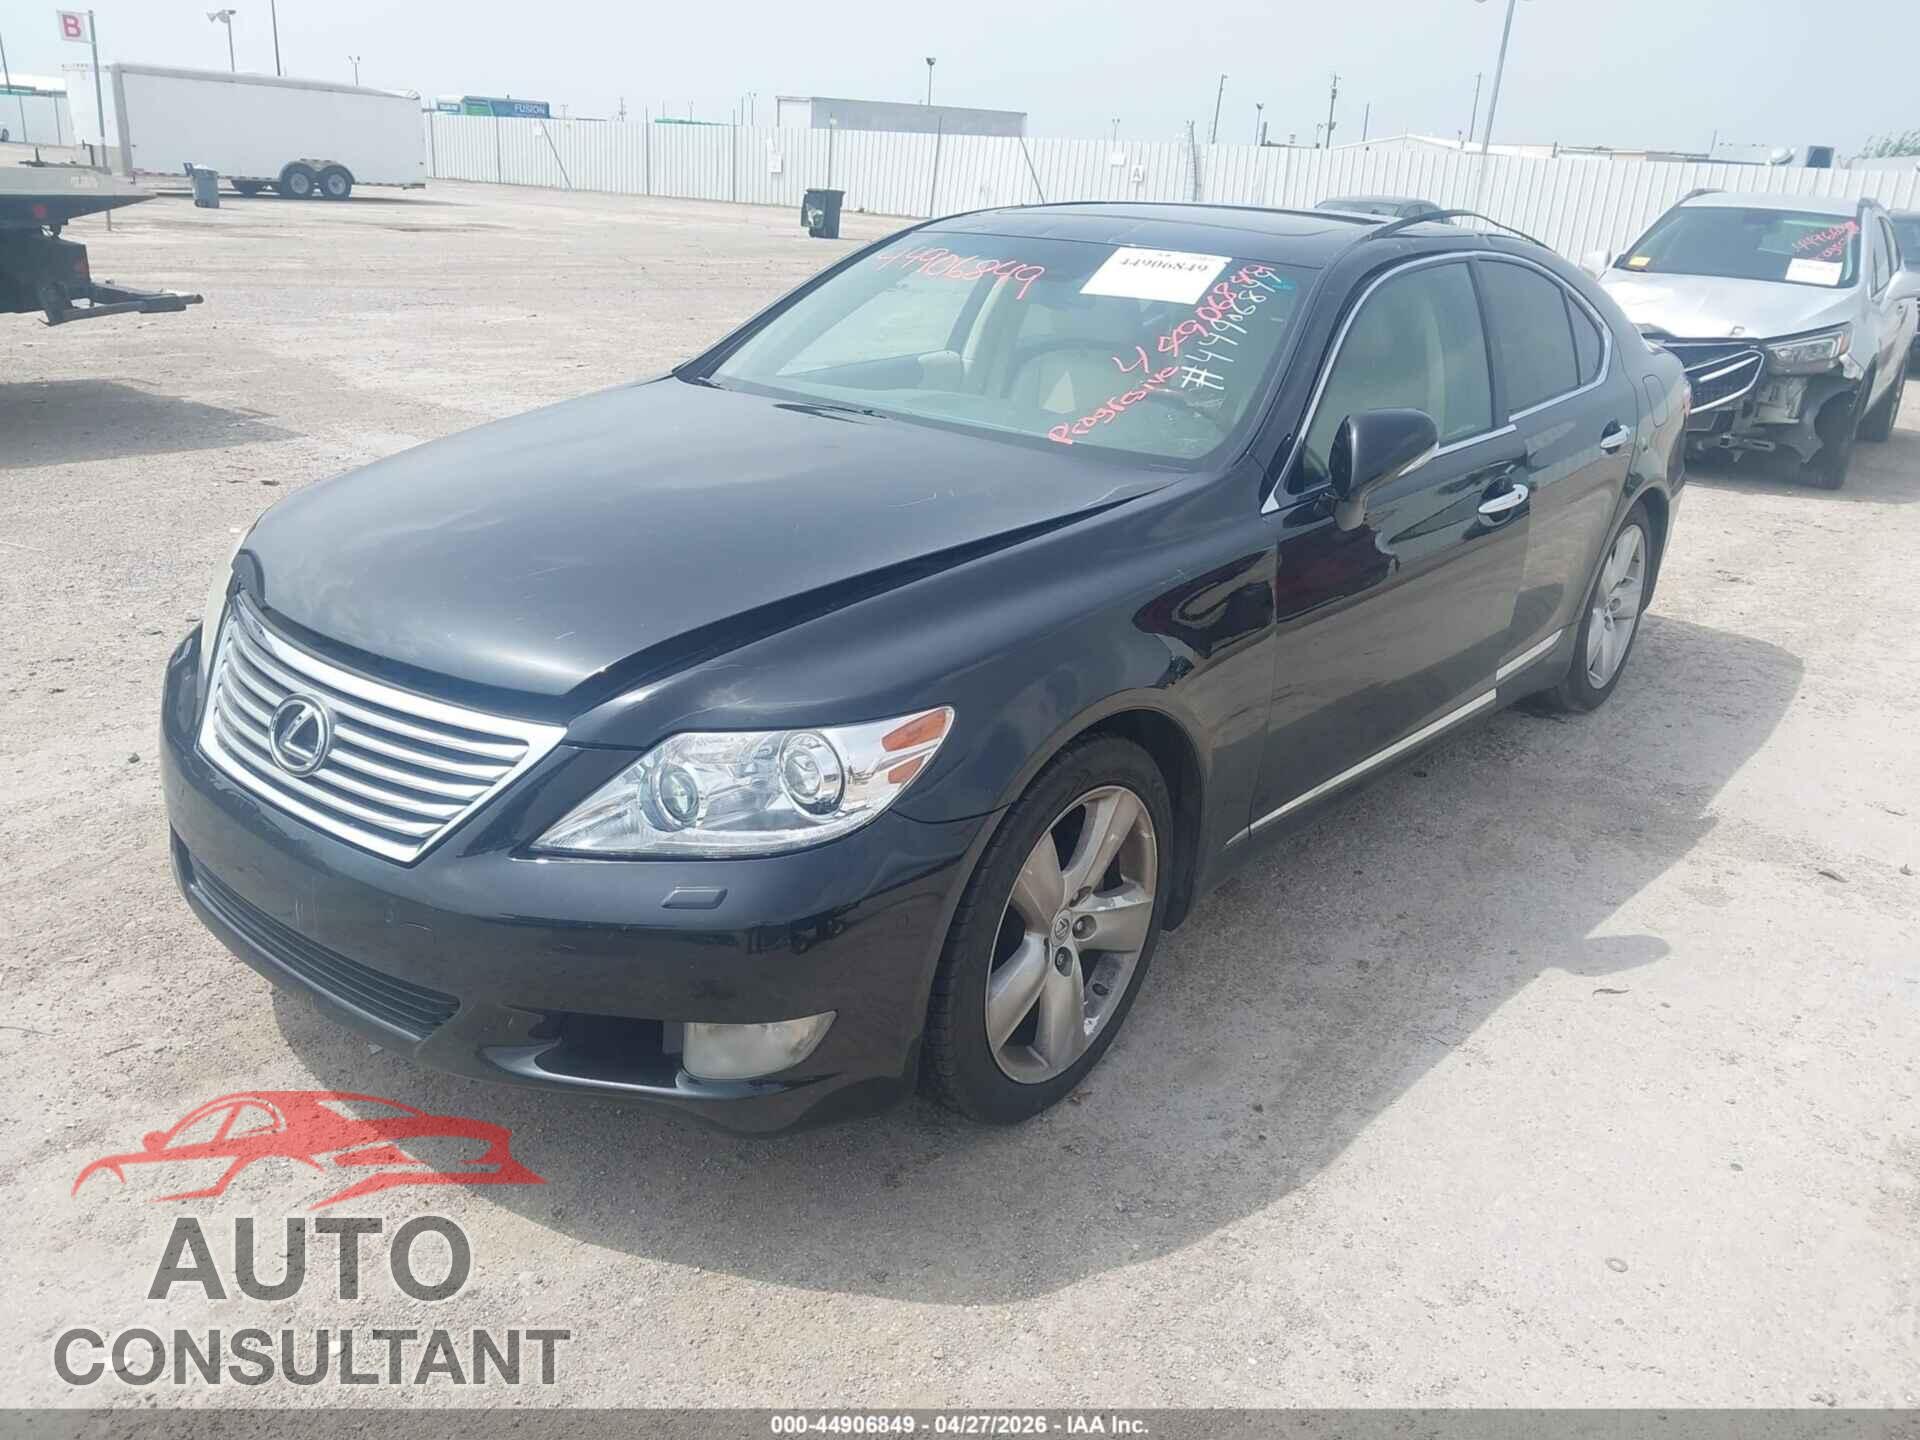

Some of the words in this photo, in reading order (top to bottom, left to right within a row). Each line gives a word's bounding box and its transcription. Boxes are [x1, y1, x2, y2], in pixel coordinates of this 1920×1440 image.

[63, 14, 81, 37] B
[514, 102, 545, 113] FUSION
[873, 247, 1046, 300] 44906849
[1120, 258, 1209, 272] 44906849
